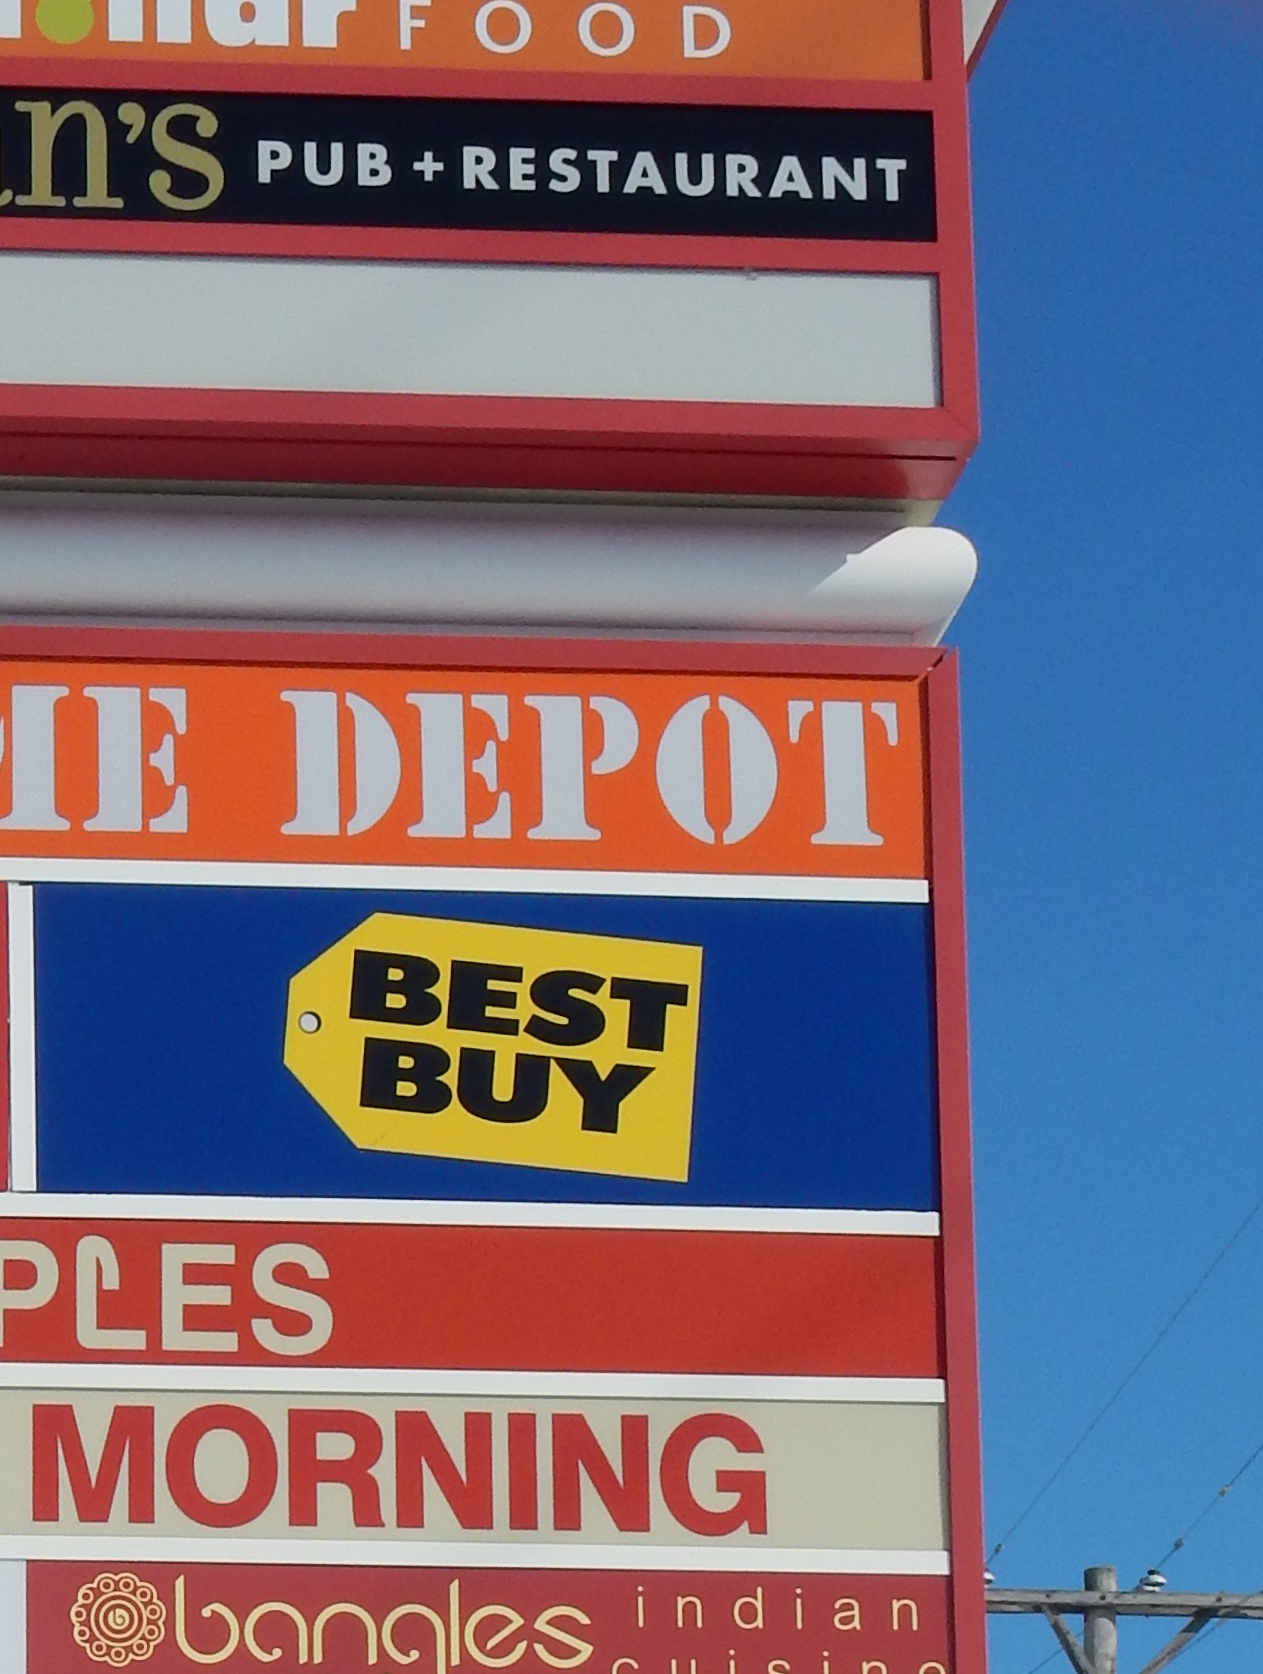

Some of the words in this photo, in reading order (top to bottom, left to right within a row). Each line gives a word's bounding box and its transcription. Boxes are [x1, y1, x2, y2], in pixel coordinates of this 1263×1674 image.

[398, 0, 732, 59] FOOD
[256, 139, 393, 187] PUB
[462, 144, 909, 203] RESTAURANT
[281, 689, 901, 847] DEPOT
[348, 948, 690, 1053] BEST
[359, 1040, 657, 1135] BUY
[30, 1403, 769, 1538] MORNING
[635, 1585, 919, 1632] indian
